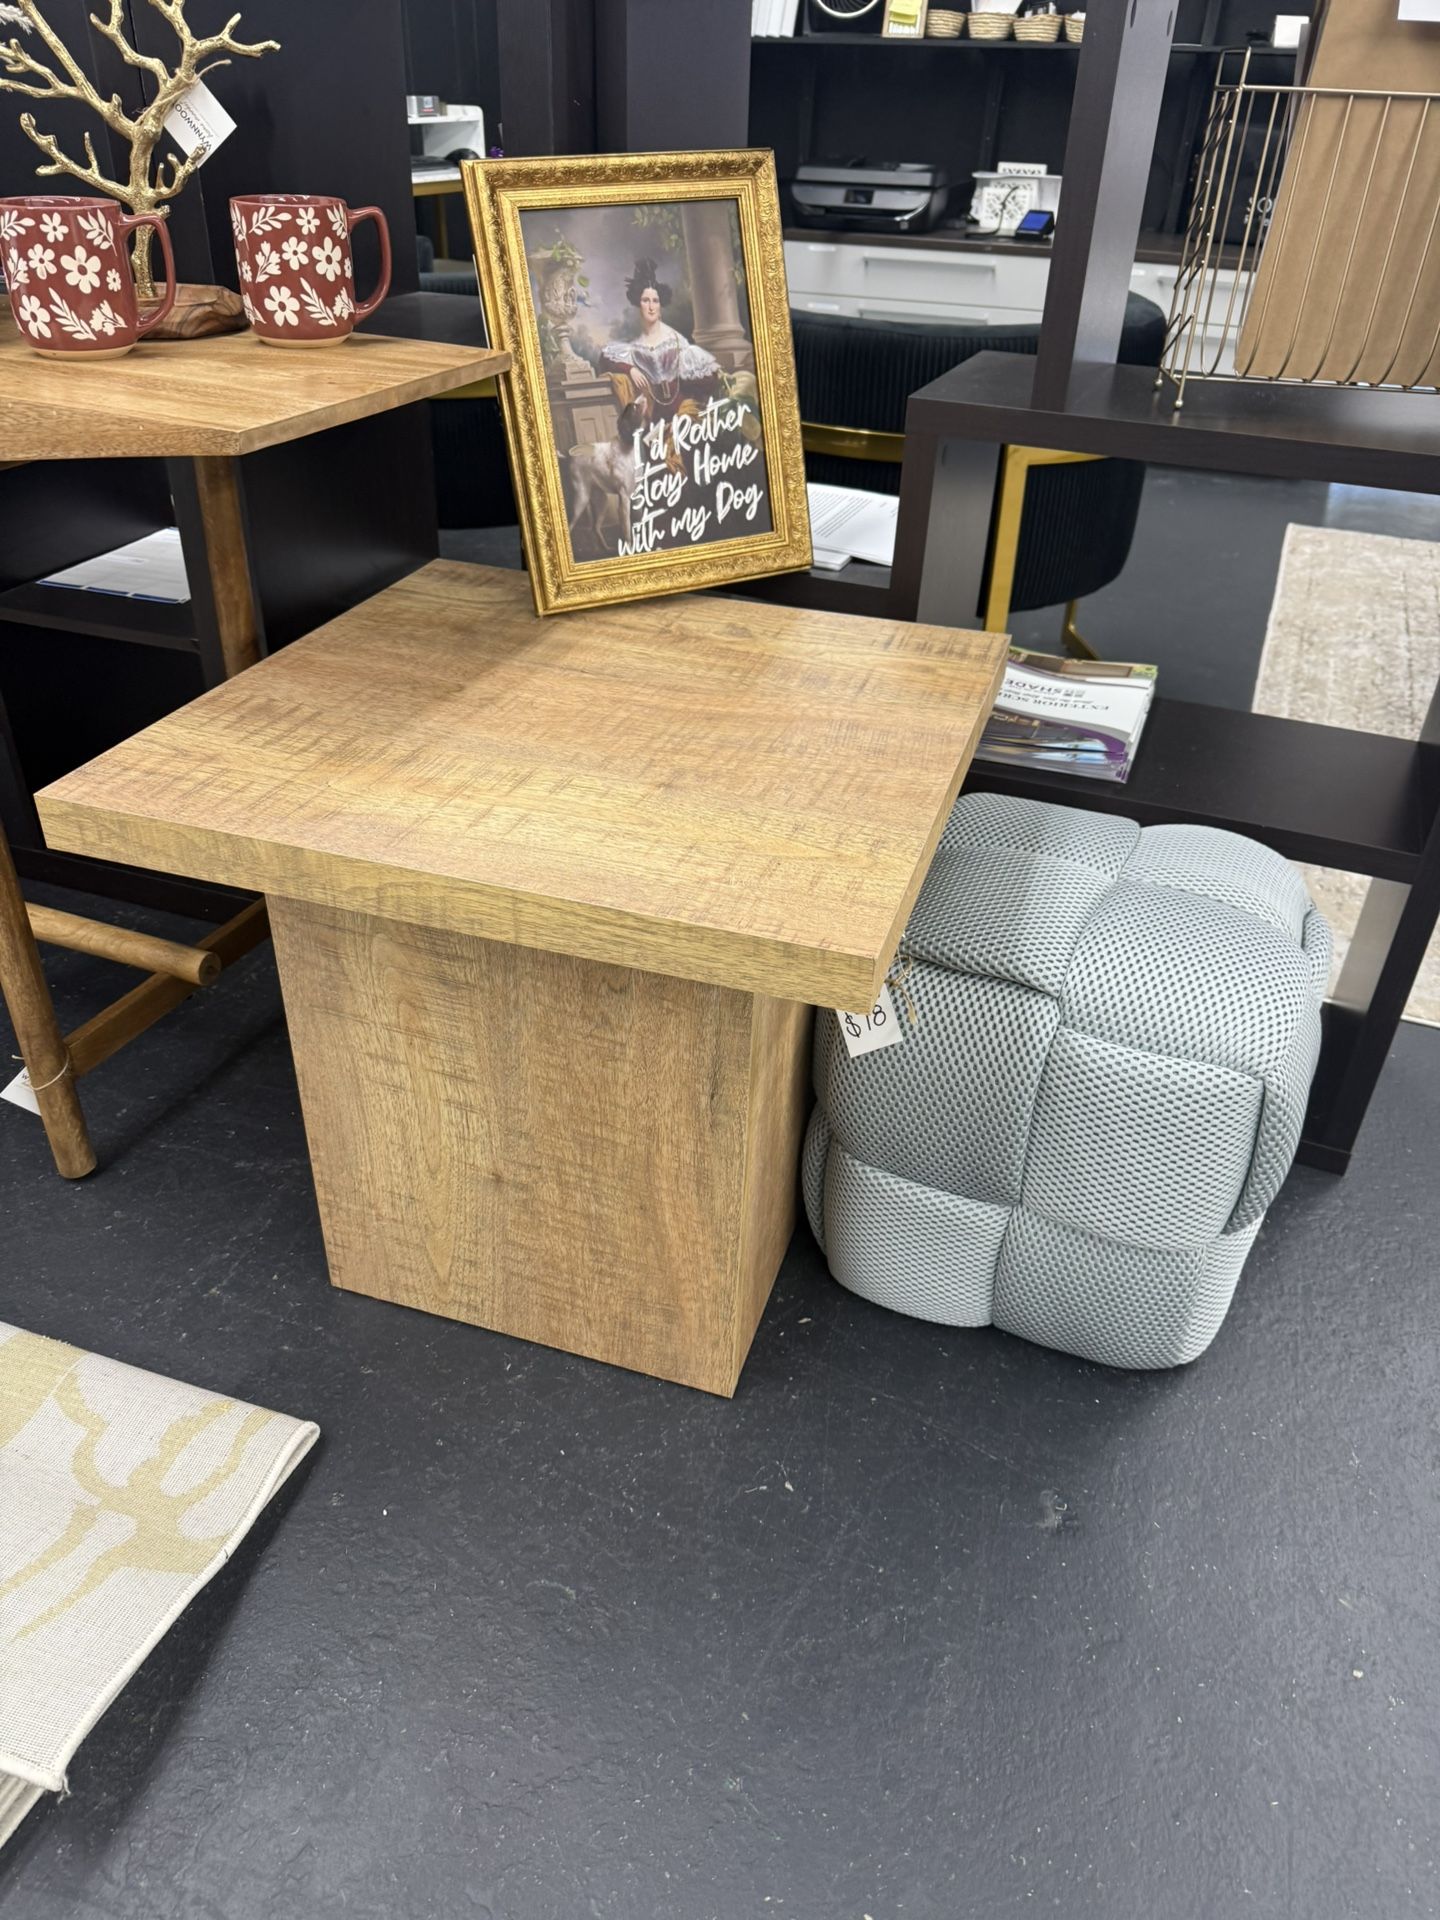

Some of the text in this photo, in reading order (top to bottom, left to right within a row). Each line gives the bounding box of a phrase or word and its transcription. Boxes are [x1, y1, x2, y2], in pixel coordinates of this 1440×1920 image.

[174, 103, 213, 151] WYNNWOO
[632, 396, 752, 469] I'd Rather
[693, 443, 758, 485] Home
[617, 507, 668, 557] with
[671, 505, 711, 541] my
[716, 481, 763, 524] Dog
[845, 1004, 887, 1038] $18
